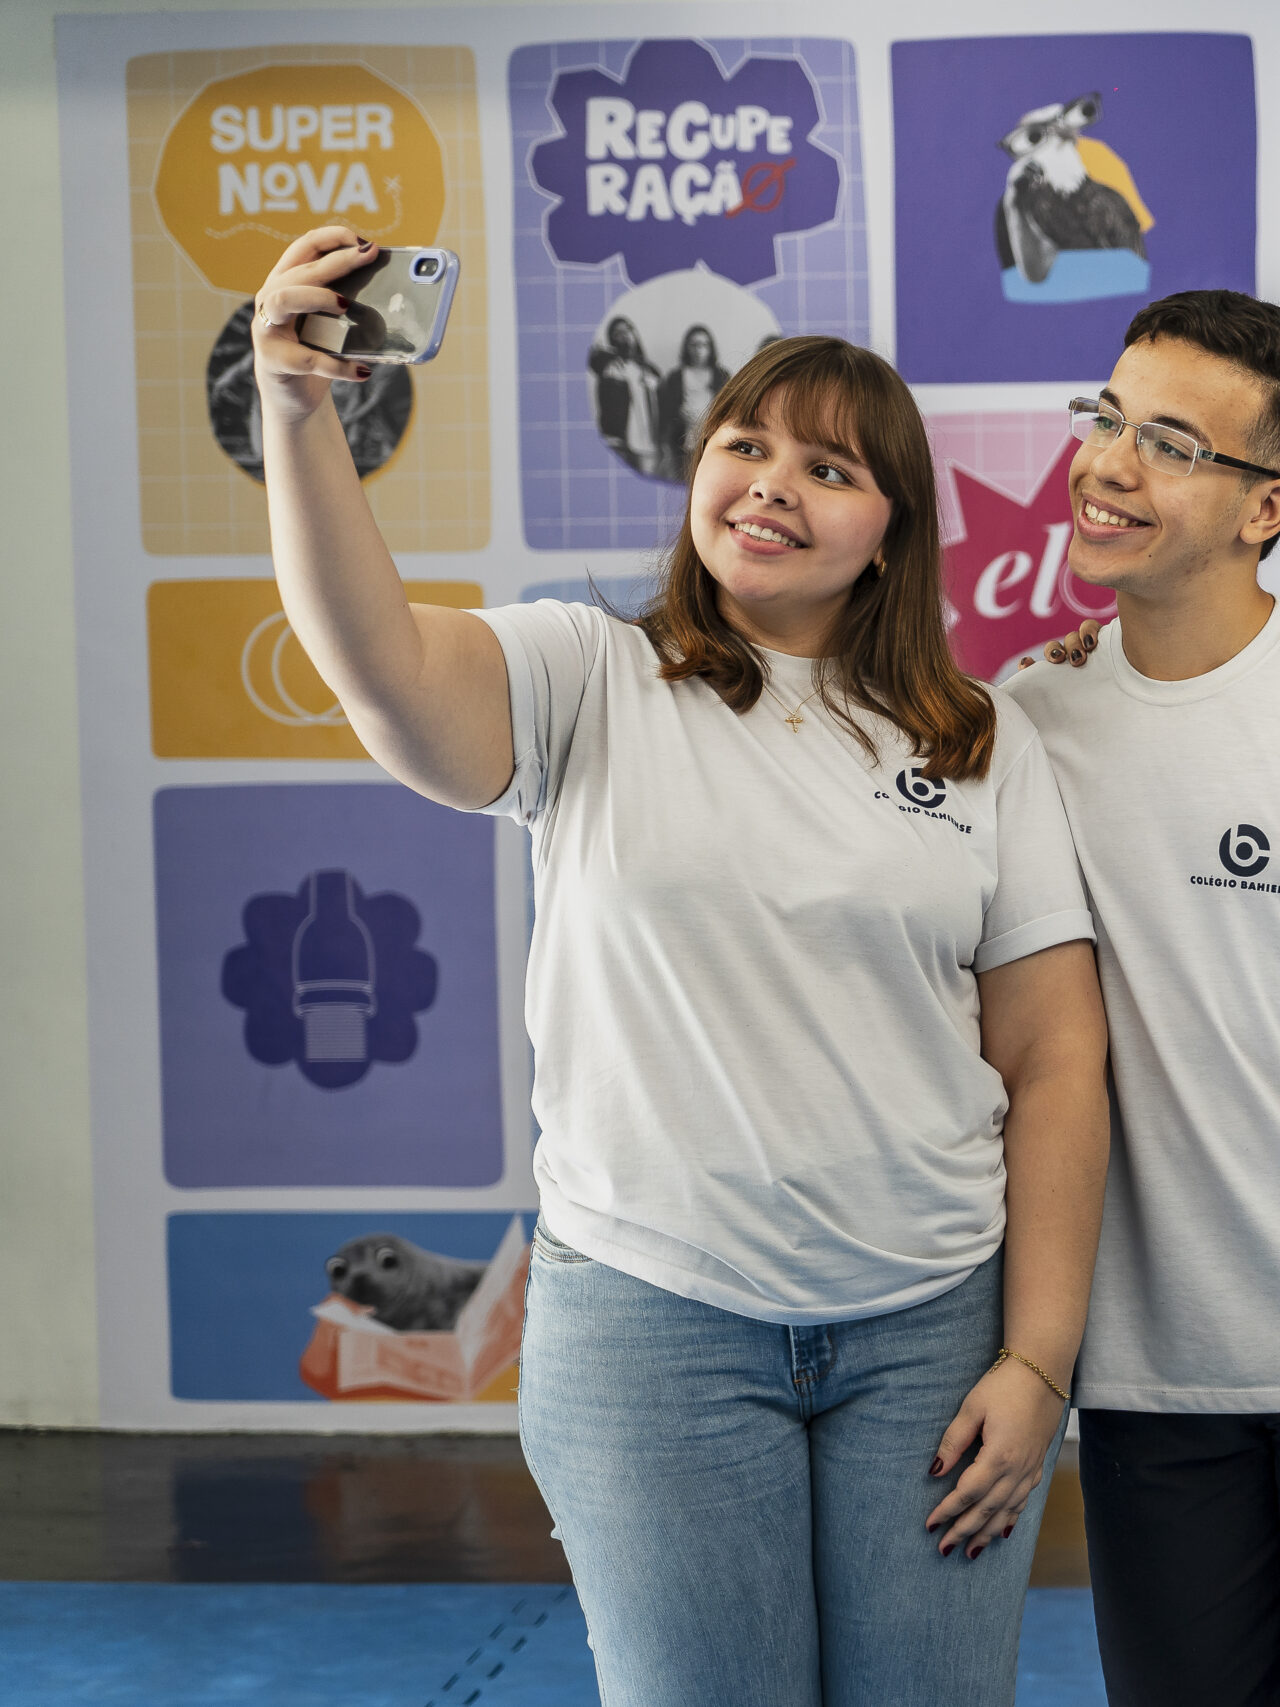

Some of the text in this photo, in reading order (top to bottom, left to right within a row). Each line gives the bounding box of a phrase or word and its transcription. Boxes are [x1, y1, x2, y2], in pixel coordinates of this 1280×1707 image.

[209, 103, 394, 153] SUPER
[217, 161, 379, 216] NOVA
[874, 791, 921, 814] COGIO
[1190, 875, 1237, 889] COLÉGIO
